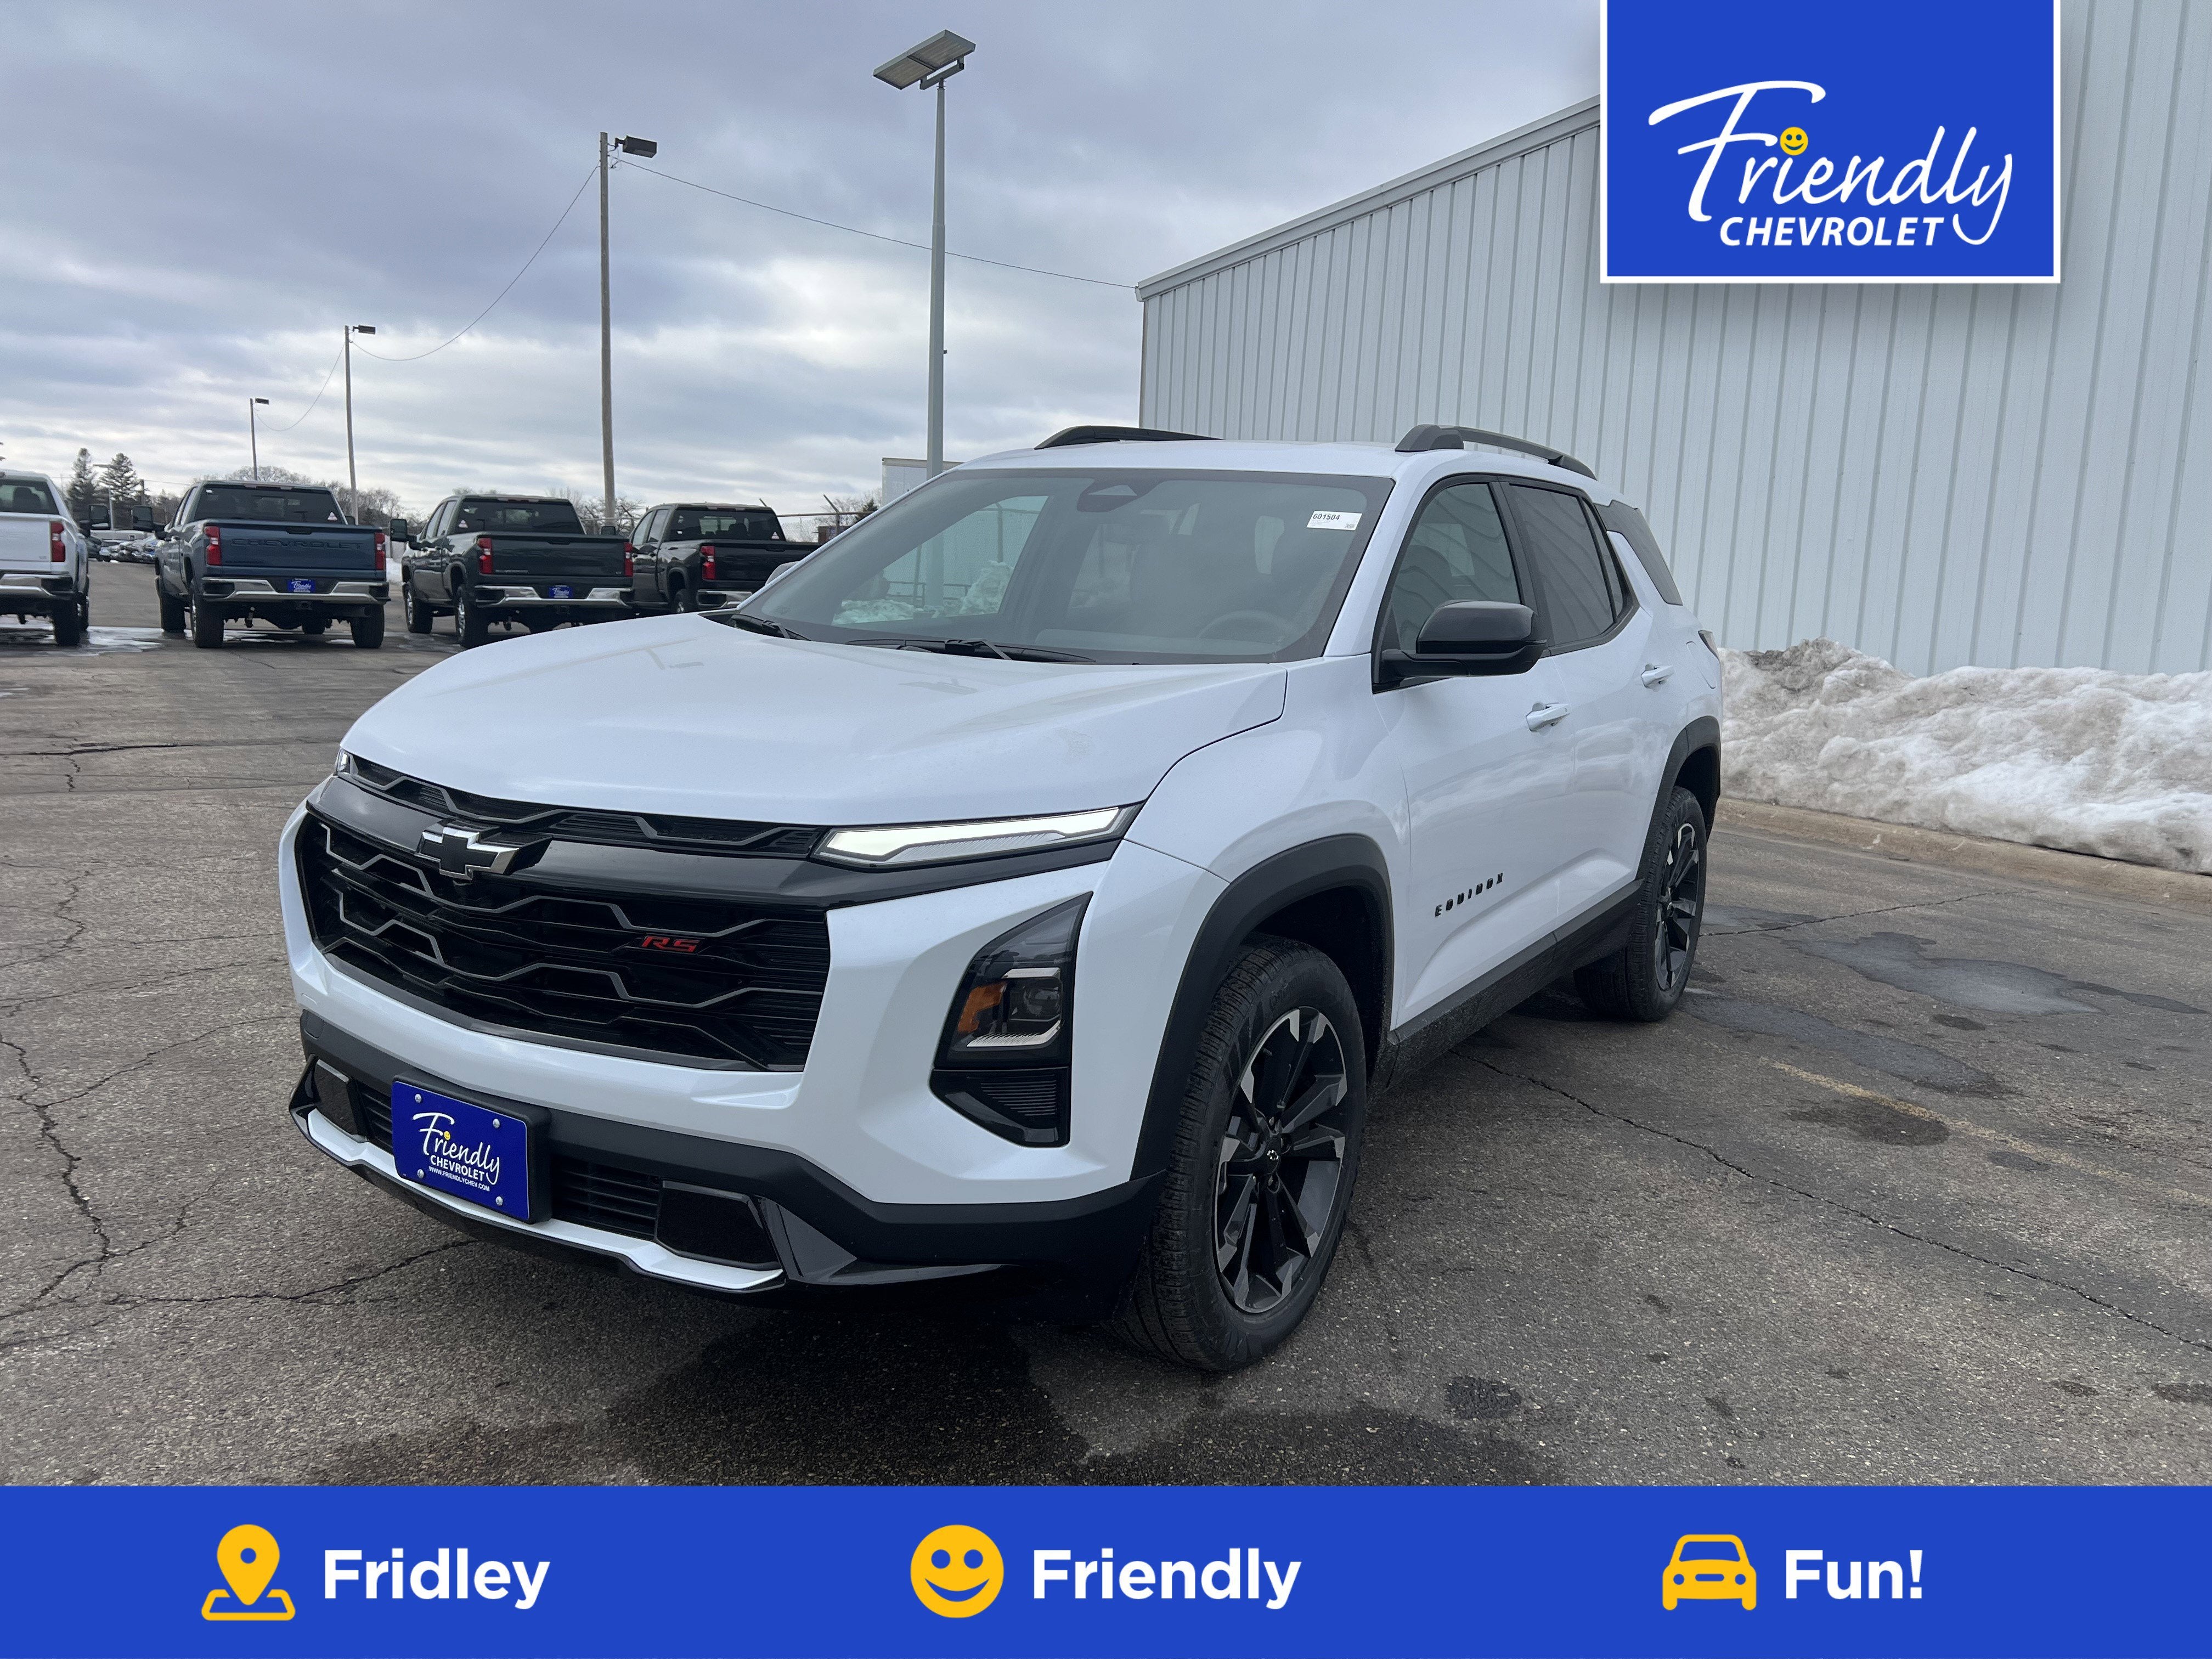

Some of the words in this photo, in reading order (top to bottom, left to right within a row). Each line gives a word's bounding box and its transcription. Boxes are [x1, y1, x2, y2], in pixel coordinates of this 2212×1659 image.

[230, 538, 364, 549] CHEVROLET
[1435, 872, 1504, 917] EQUINOX
[642, 935, 700, 953] RS
[413, 1112, 500, 1185] Friendly
[428, 1166, 490, 1192] WWW.FRIENDLYCHEV.COM
[430, 1154, 484, 1181] CHEVROLET
